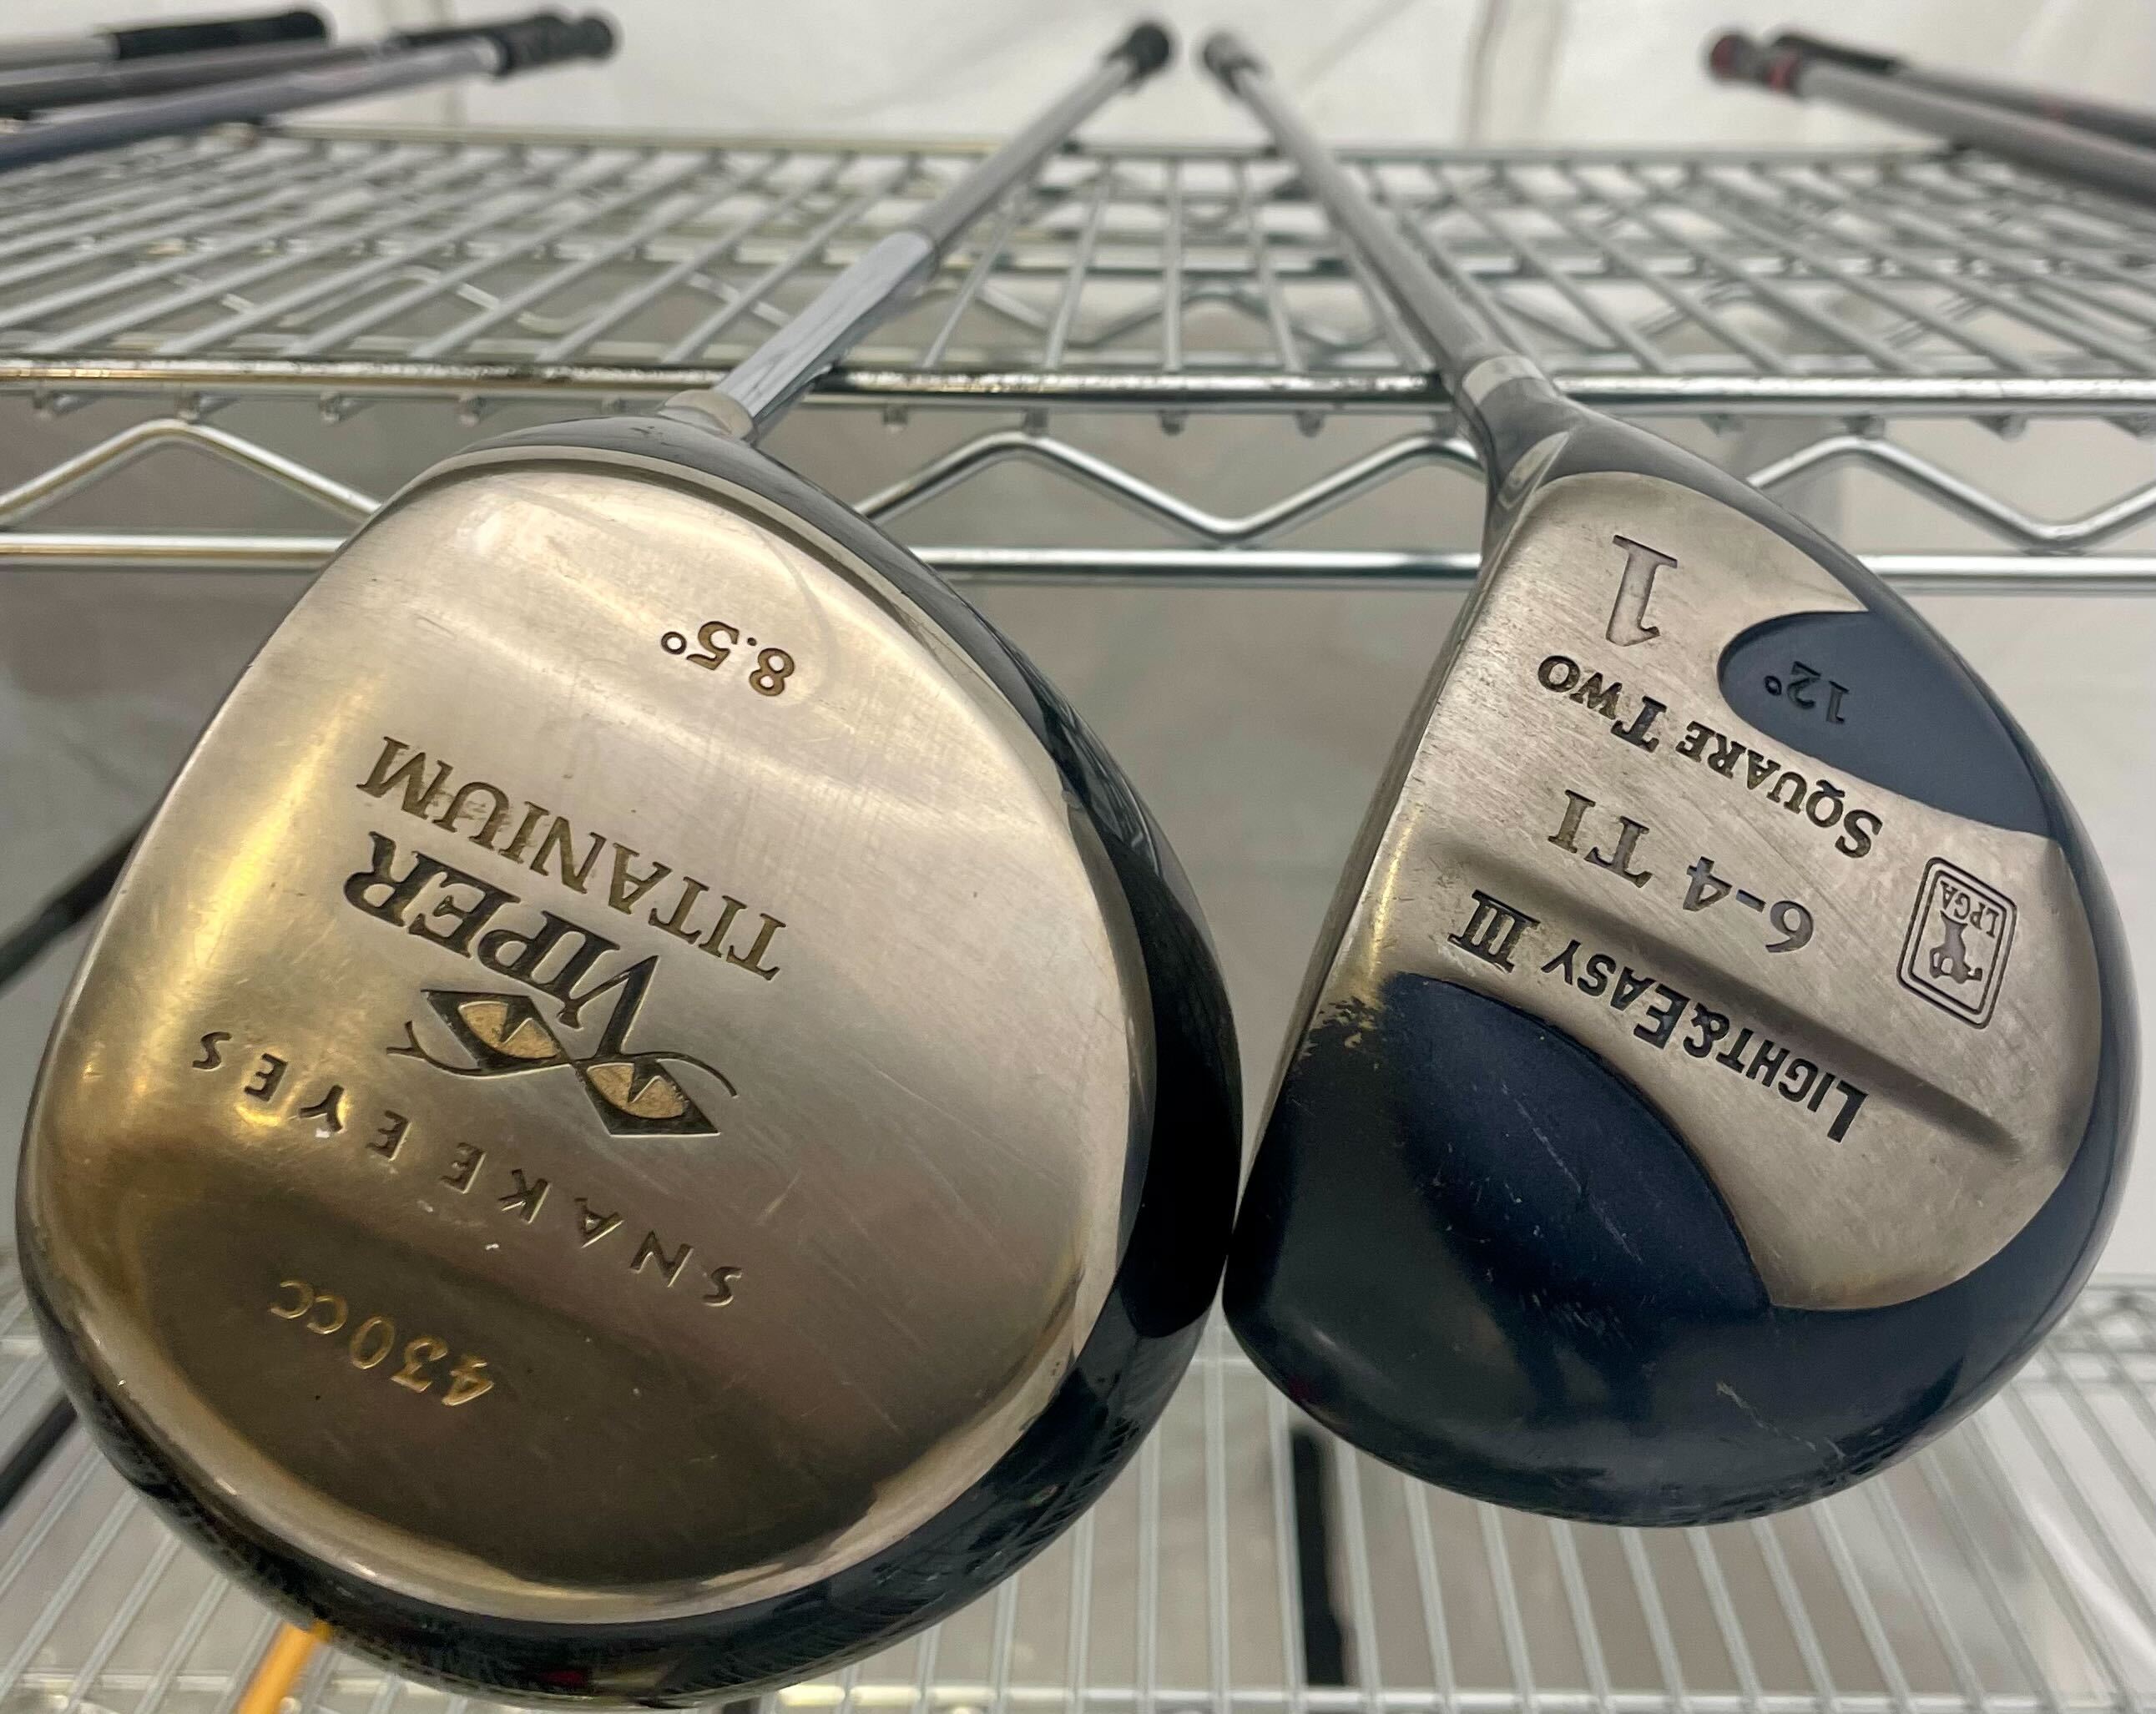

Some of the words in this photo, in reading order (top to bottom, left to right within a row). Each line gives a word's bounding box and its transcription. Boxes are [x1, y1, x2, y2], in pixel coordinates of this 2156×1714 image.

[1605, 534, 1679, 648] 1
[660, 620, 796, 697] 8.5°
[1537, 654, 1669, 753] TWO
[1764, 660, 1851, 725] 12°
[1547, 789, 1653, 889] TI
[1674, 720, 1884, 860] SQUARE
[356, 735, 787, 981] TITANIUM
[1682, 855, 1815, 954] 6-4
[342, 830, 660, 1058] VIPER
[1447, 889, 1541, 973] III
[1939, 880, 2001, 938] LPGA
[192, 1031, 412, 1161] EYES
[441, 1142, 743, 1307] SNAKE
